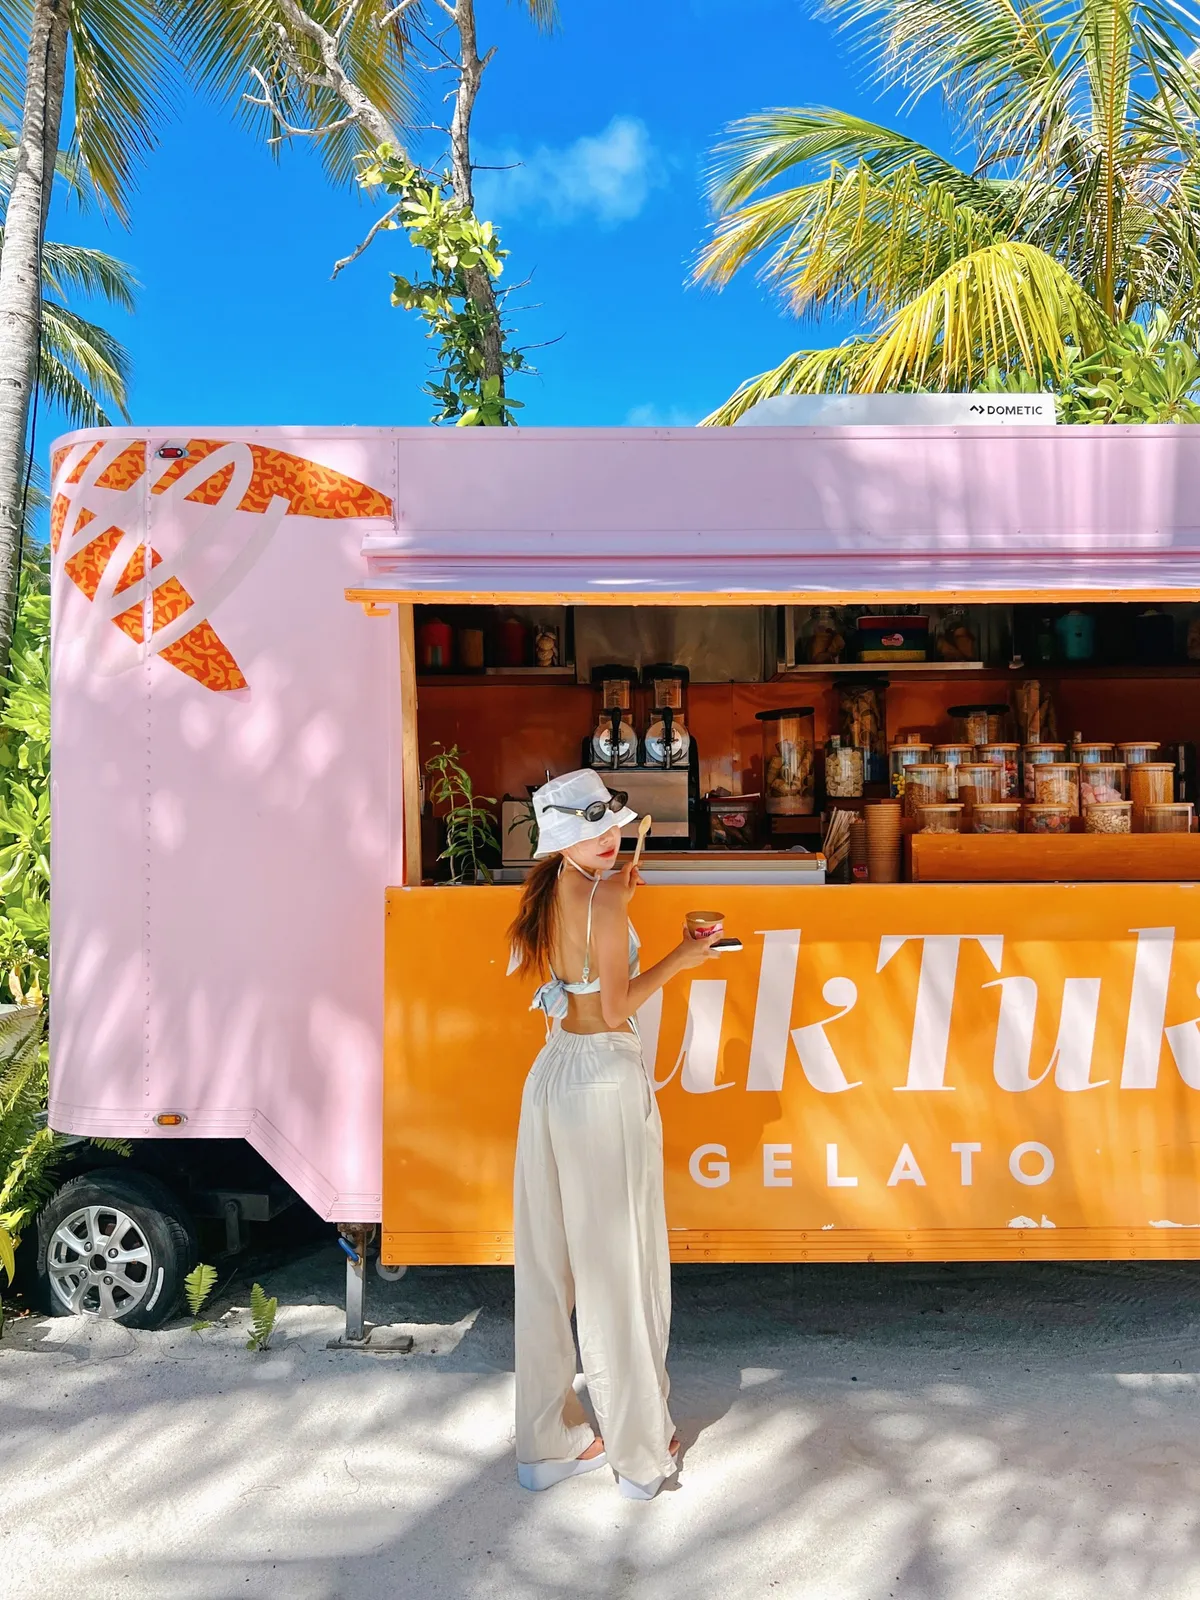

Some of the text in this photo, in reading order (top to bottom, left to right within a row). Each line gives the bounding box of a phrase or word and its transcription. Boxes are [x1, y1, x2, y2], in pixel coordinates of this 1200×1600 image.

[987, 405, 1043, 415] DOMETIC
[506, 925, 1200, 1093] ukTuk
[689, 1141, 1055, 1188] GELATO
